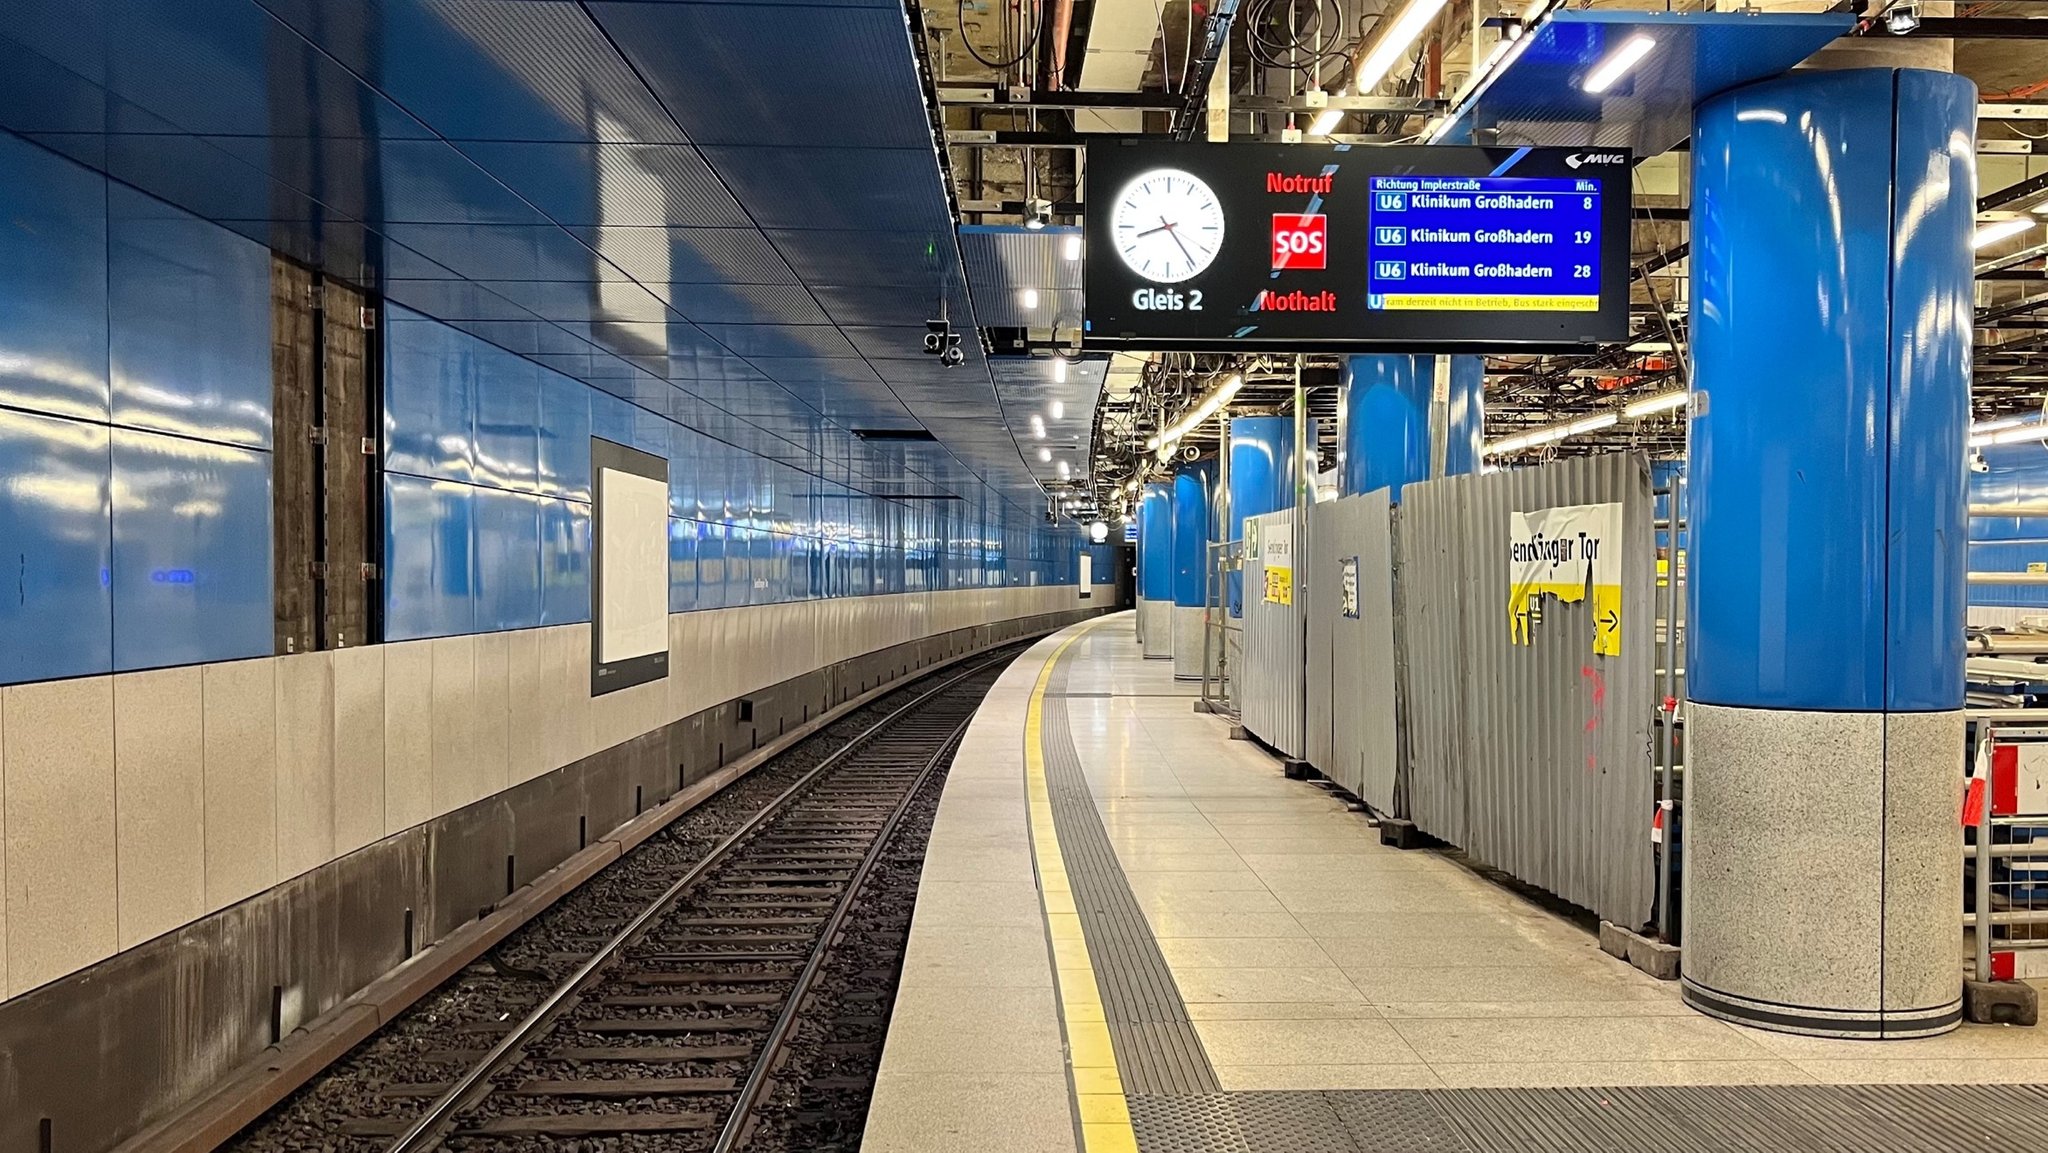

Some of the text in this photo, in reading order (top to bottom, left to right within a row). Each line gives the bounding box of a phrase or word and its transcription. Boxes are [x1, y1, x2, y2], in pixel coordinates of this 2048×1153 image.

[1582, 153, 1624, 164] MVG
[1267, 172, 1332, 193] Notruf
[1376, 180, 1597, 192] Richtung Implerstraße Min.
[1380, 195, 1592, 210] U6 Klinikum Großhadern 8
[1275, 231, 1323, 254] SOS
[1379, 229, 1591, 244] U6 Klinikum Großhadern 19
[1379, 263, 1591, 278] U6 Klinikum Großhadern 28
[1133, 288, 1203, 310] Gleis 2
[1260, 290, 1336, 311] Nothalt
[1406, 297, 1437, 306] derzeit
[1439, 298, 1461, 306] nicht
[1464, 298, 1473, 306] in
[1475, 298, 1511, 308] Betrieb,
[1513, 299, 1530, 307] Bus
[1532, 299, 1554, 307] stark
[1578, 532, 1600, 560] Tor
[1529, 595, 1541, 611] U1
